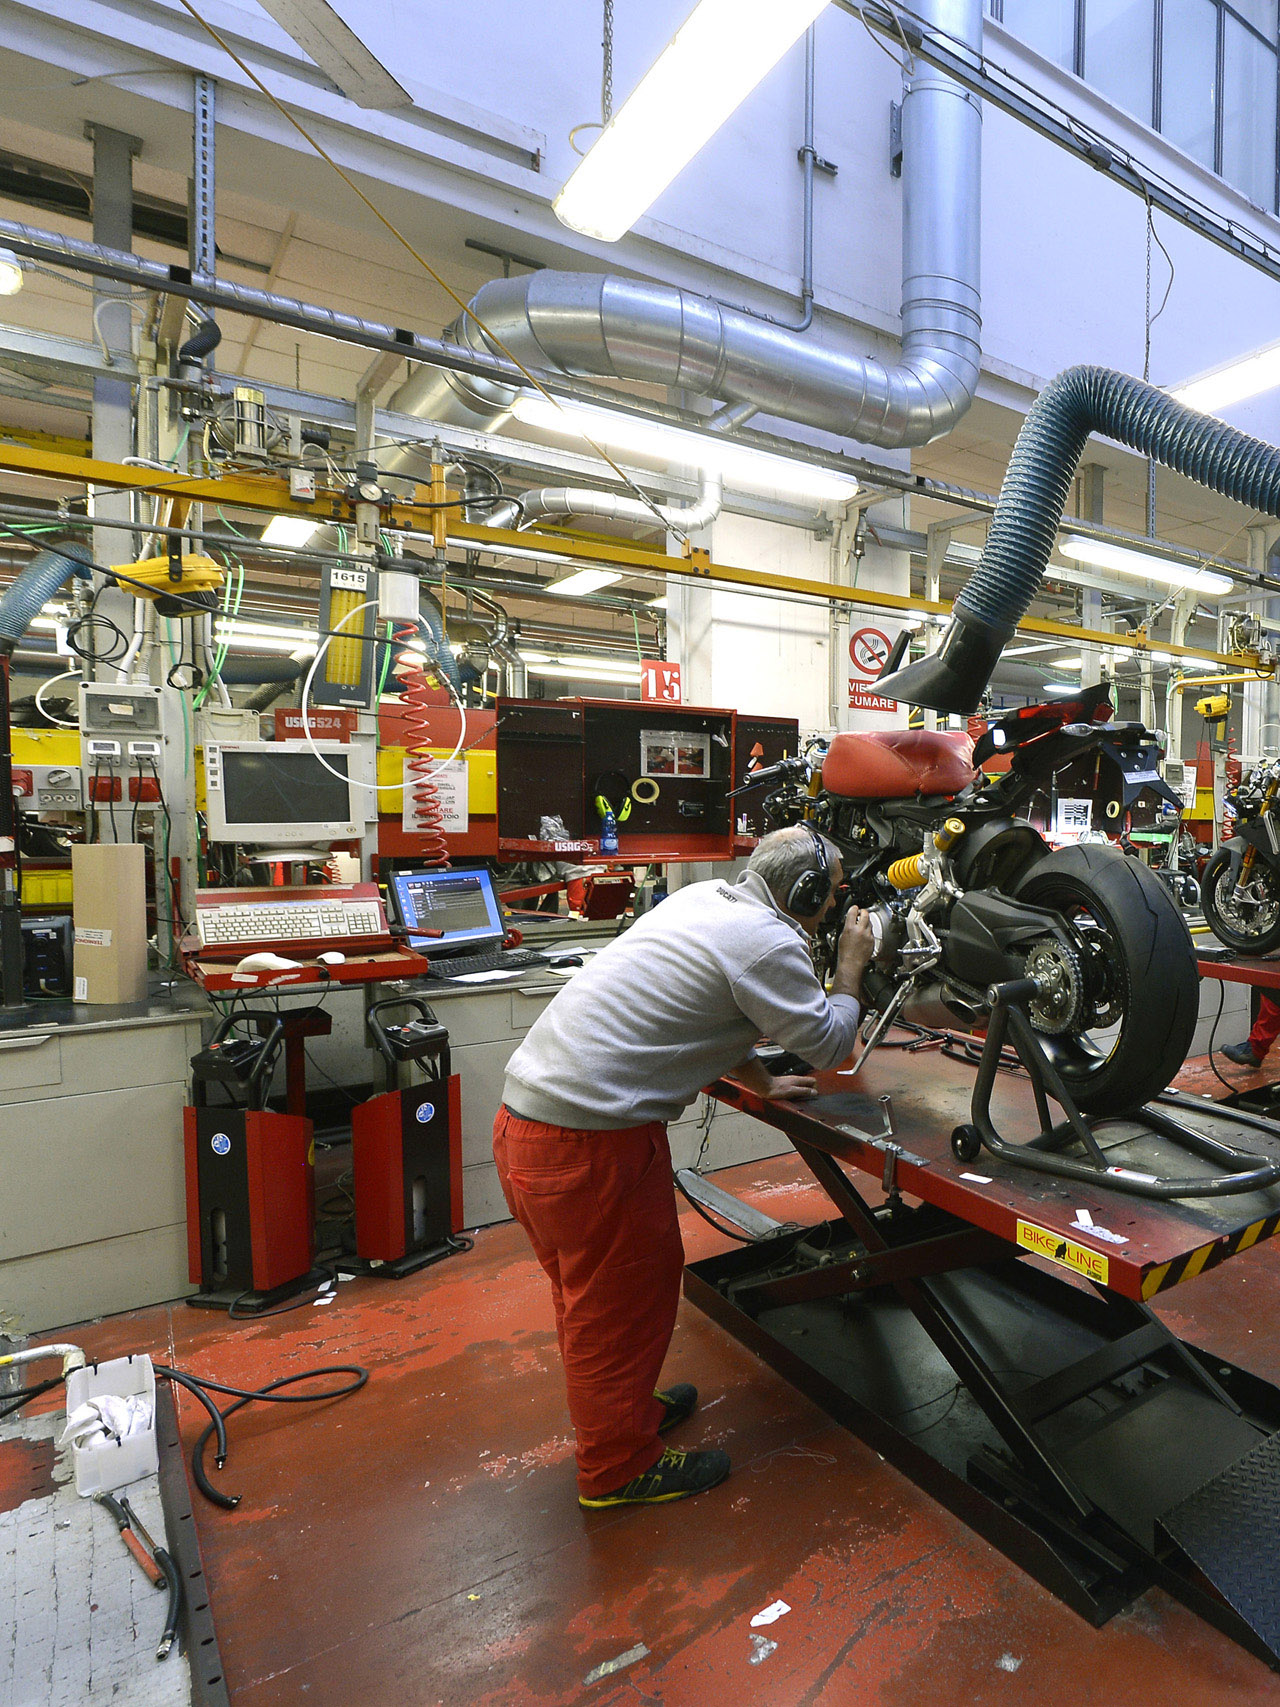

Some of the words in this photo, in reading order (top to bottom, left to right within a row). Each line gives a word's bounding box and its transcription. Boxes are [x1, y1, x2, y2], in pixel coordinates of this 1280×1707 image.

[332, 572, 365, 583] 1615
[641, 668, 680, 701] 15
[849, 695, 894, 709] FUMARE
[317, 717, 341, 729] 524
[555, 841, 581, 852] USAG
[716, 886, 738, 904] DUCATI
[1023, 1227, 1055, 1254] BIKE
[1067, 1246, 1102, 1274] LINE
